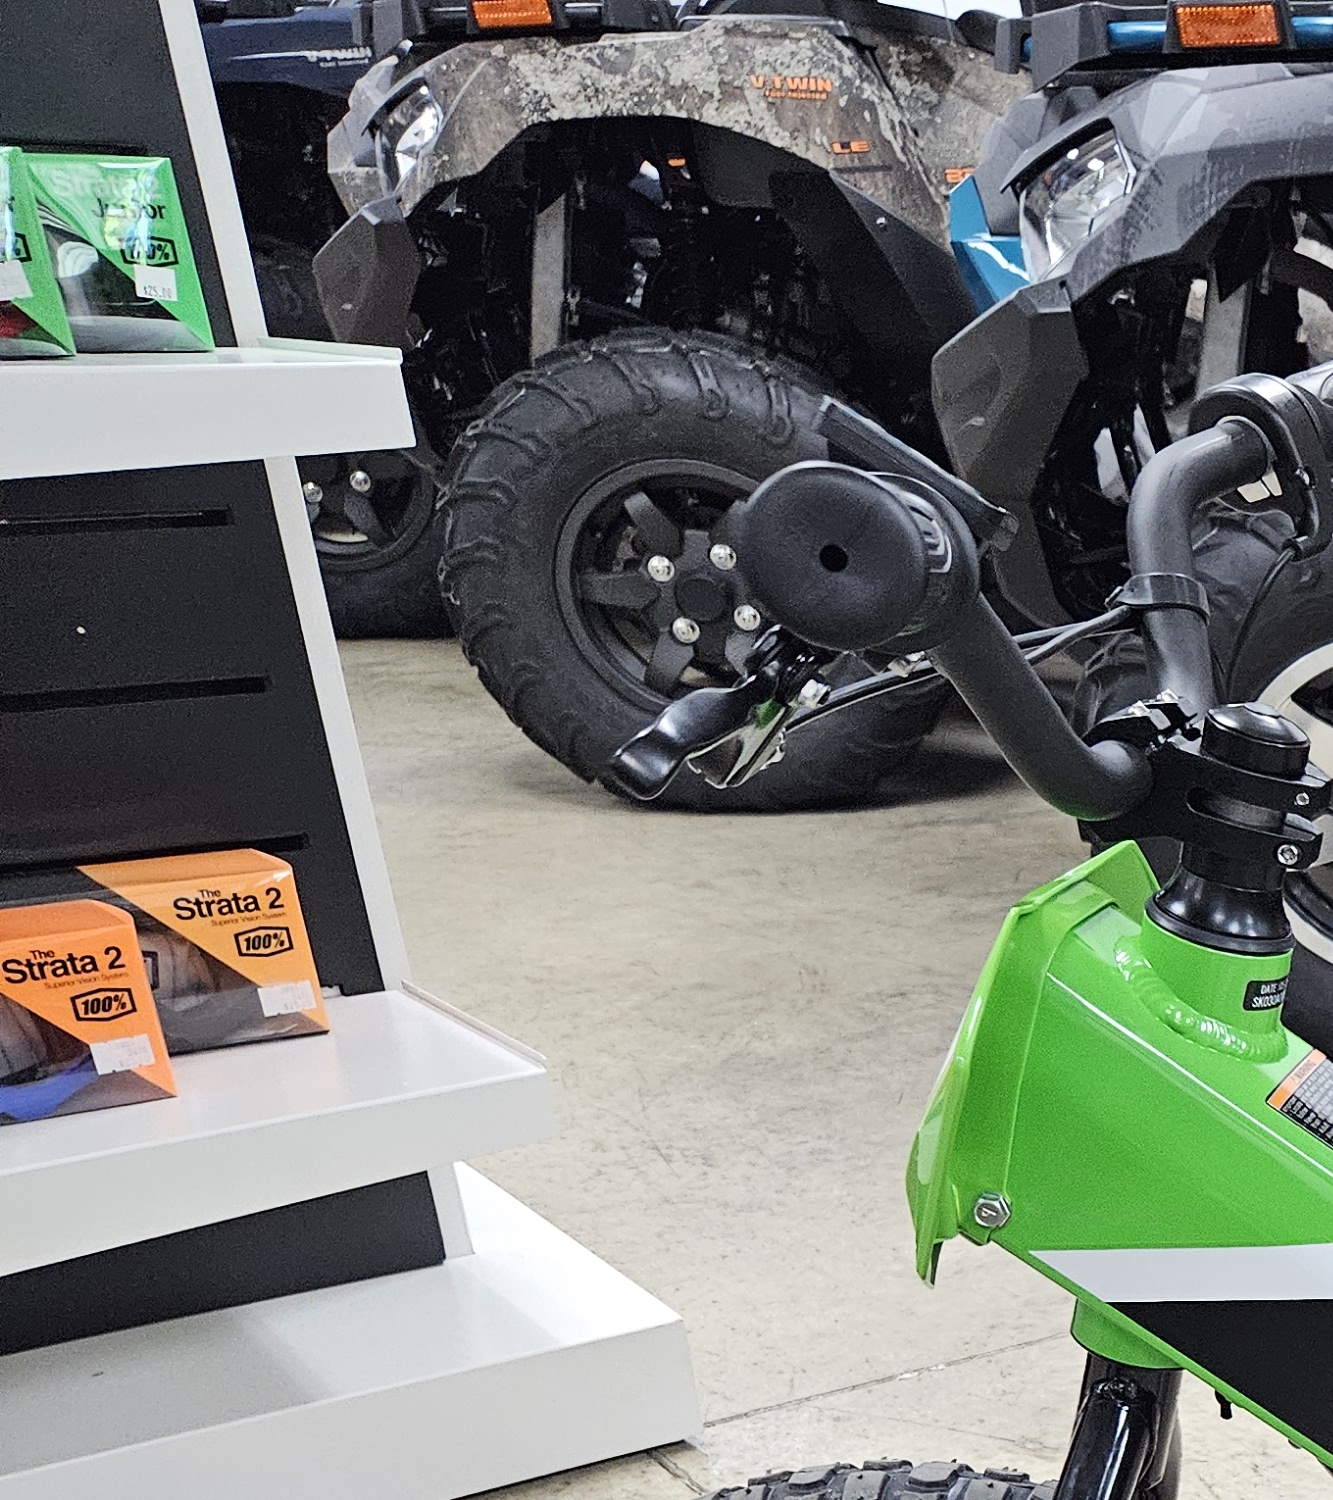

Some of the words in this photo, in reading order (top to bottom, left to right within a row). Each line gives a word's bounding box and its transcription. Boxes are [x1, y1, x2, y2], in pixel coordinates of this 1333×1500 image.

[750, 74, 832, 91] VTWIN
[831, 140, 870, 153] LE
[199, 888, 221, 899] The
[173, 892, 261, 921] Strata
[265, 886, 285, 910] 2
[243, 932, 285, 952] 100%
[29, 949, 55, 961] The
[2, 954, 99, 985] Strata
[103, 945, 126, 971] 2
[81, 993, 127, 1017] 100%
